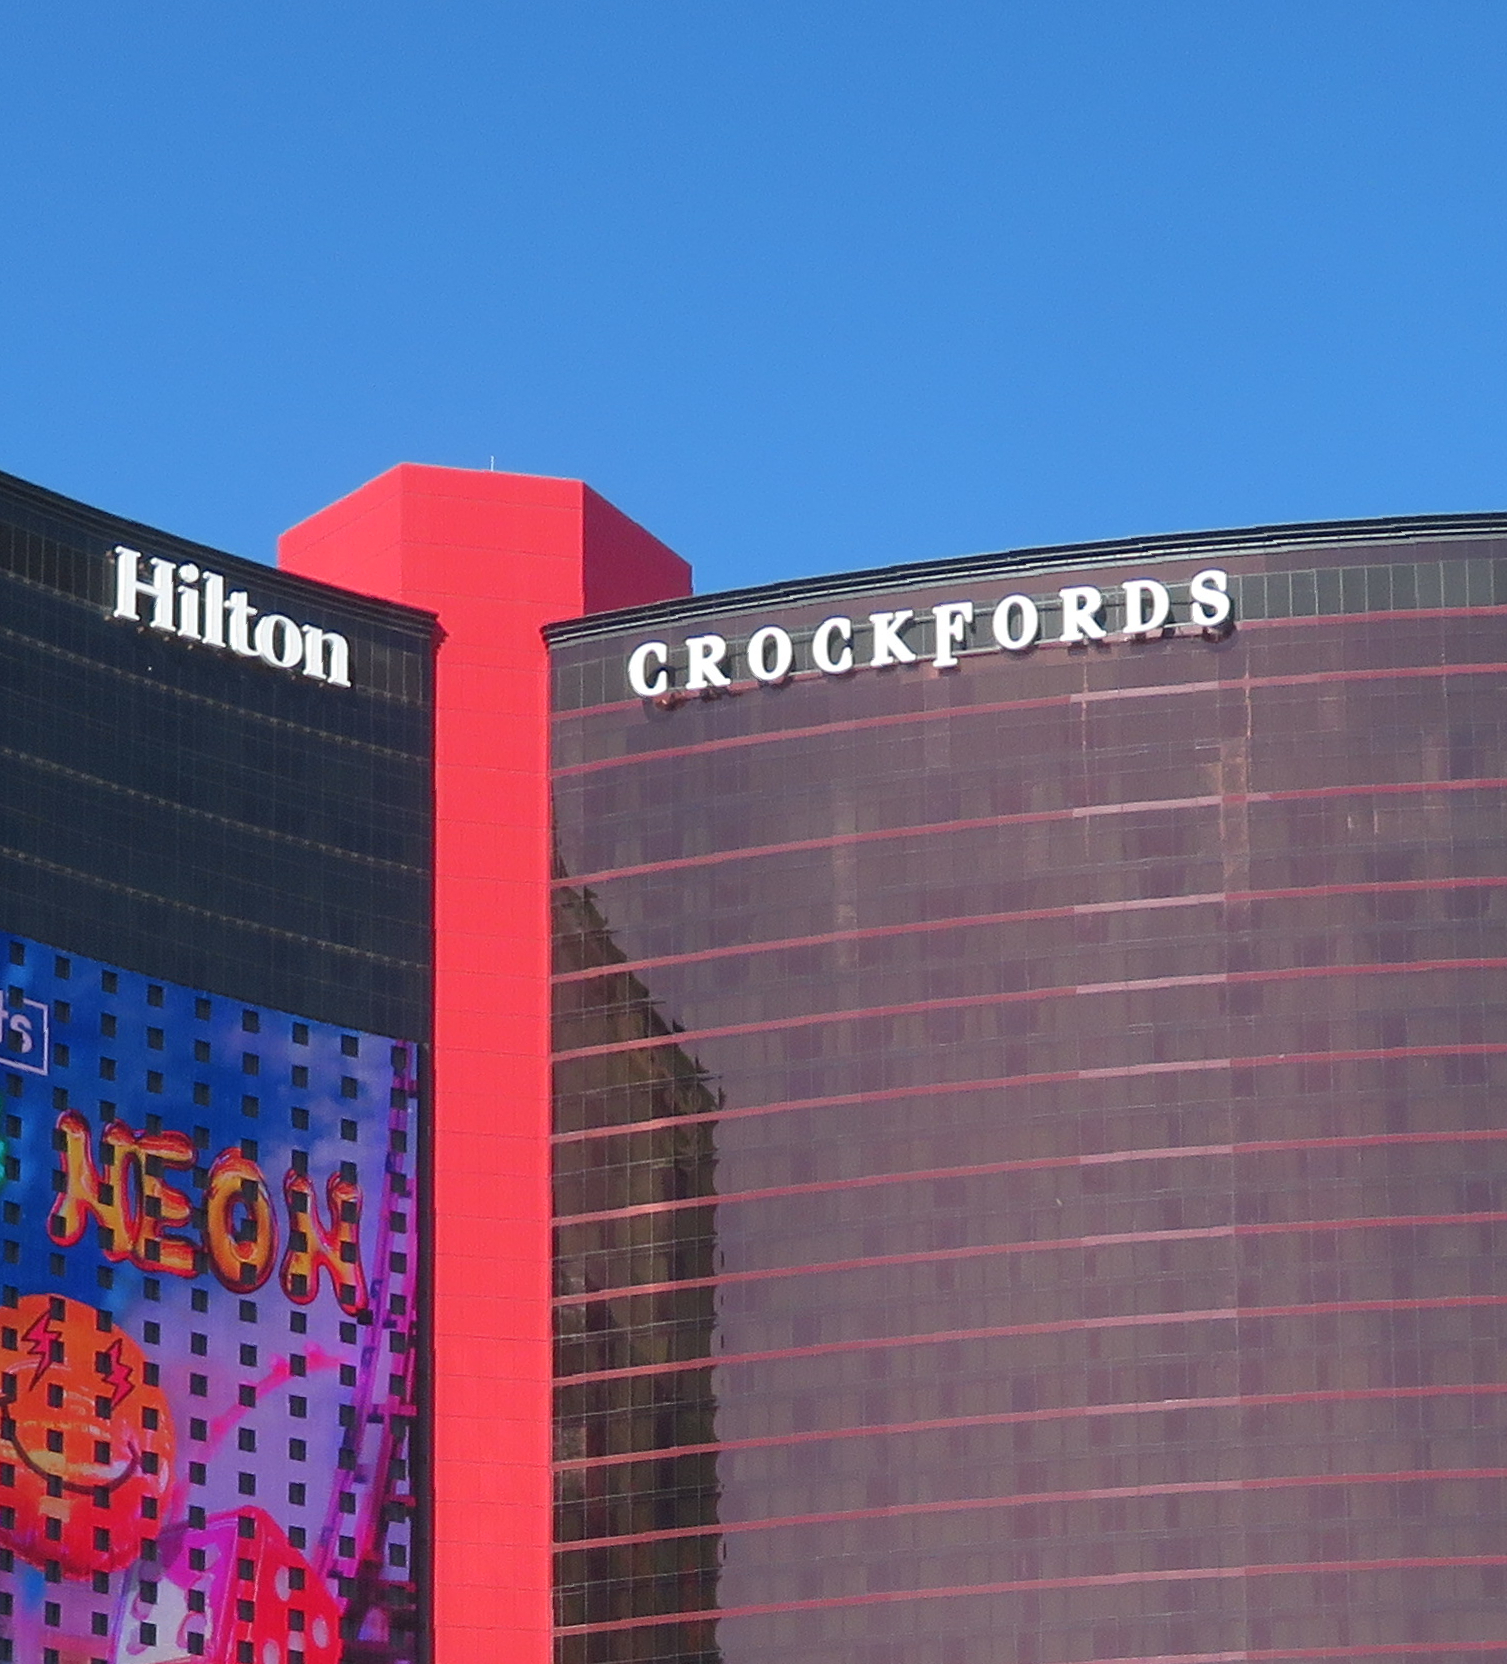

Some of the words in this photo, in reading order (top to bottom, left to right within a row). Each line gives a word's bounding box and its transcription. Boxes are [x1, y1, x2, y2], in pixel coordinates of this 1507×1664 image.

[113, 545, 352, 688] Hilton
[627, 568, 1231, 698] CROCKFORDS
[46, 1108, 370, 1317] NEON
